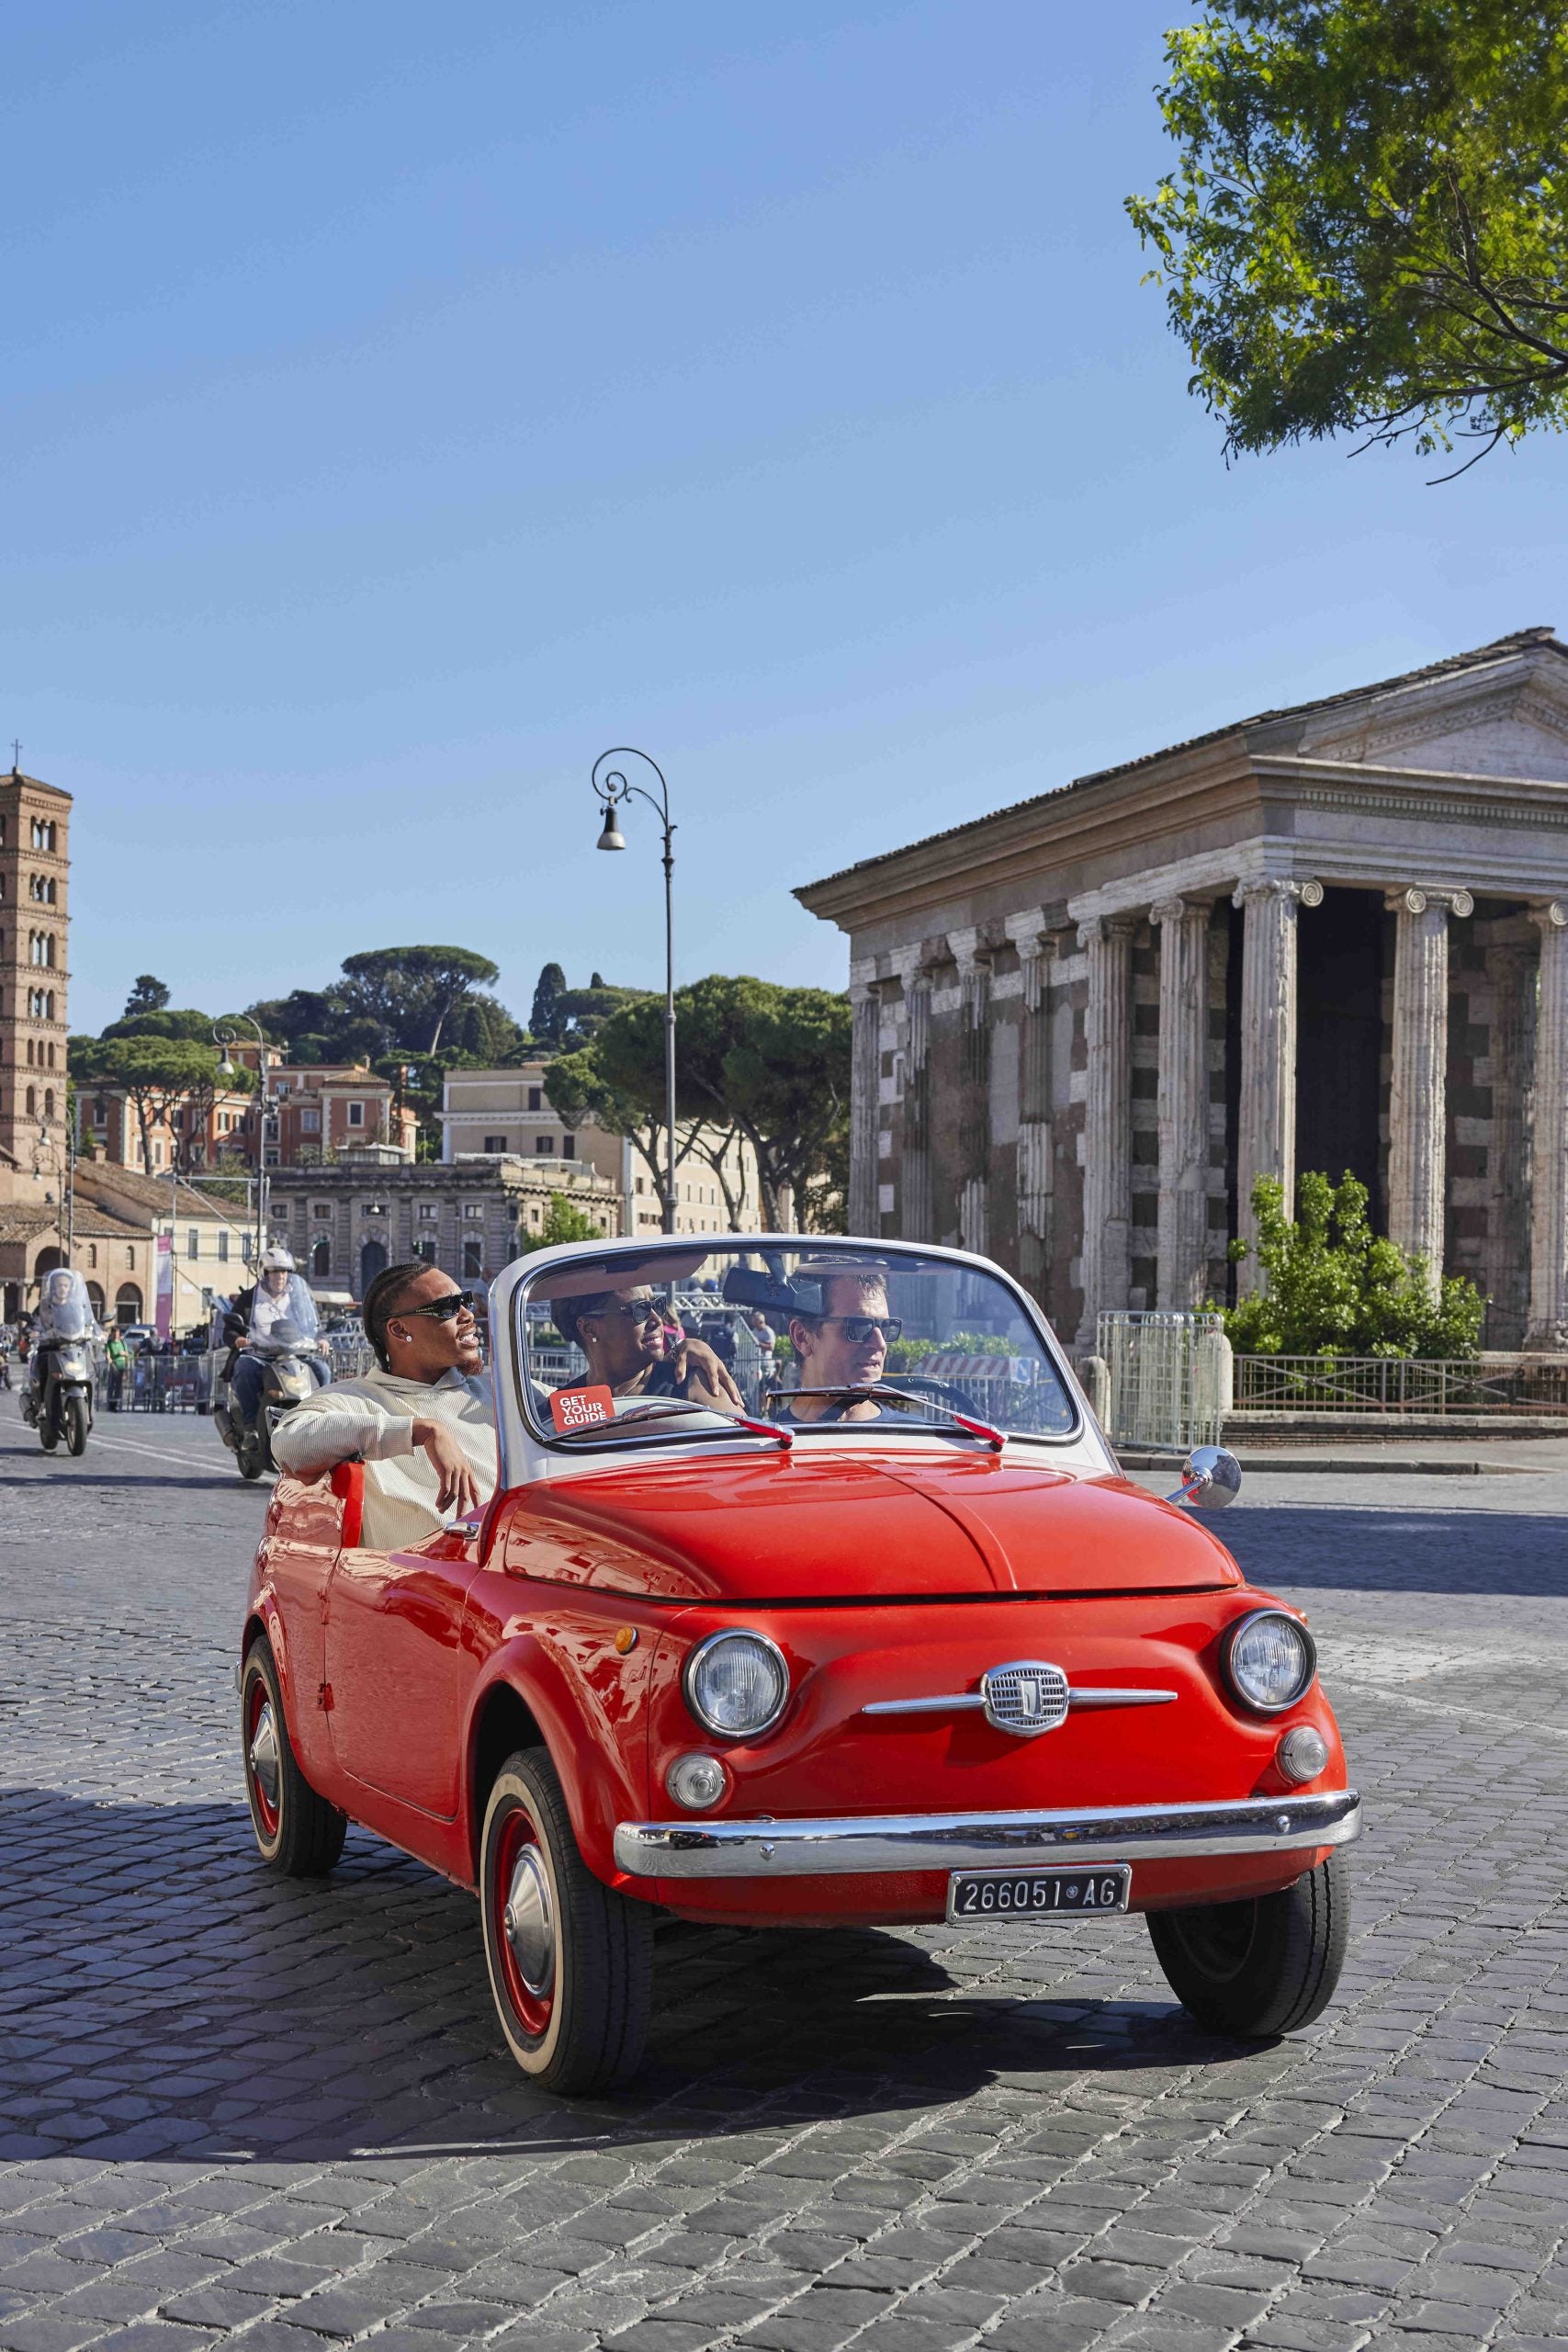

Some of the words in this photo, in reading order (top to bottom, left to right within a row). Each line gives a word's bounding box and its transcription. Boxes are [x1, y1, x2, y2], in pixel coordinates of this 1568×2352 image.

[560, 1395, 587, 1407] GET
[561, 1402, 603, 1416] YOUR
[563, 1411, 607, 1425] GUIDE
[963, 1881, 1060, 1911] 266051
[1082, 1878, 1115, 1905] AG
